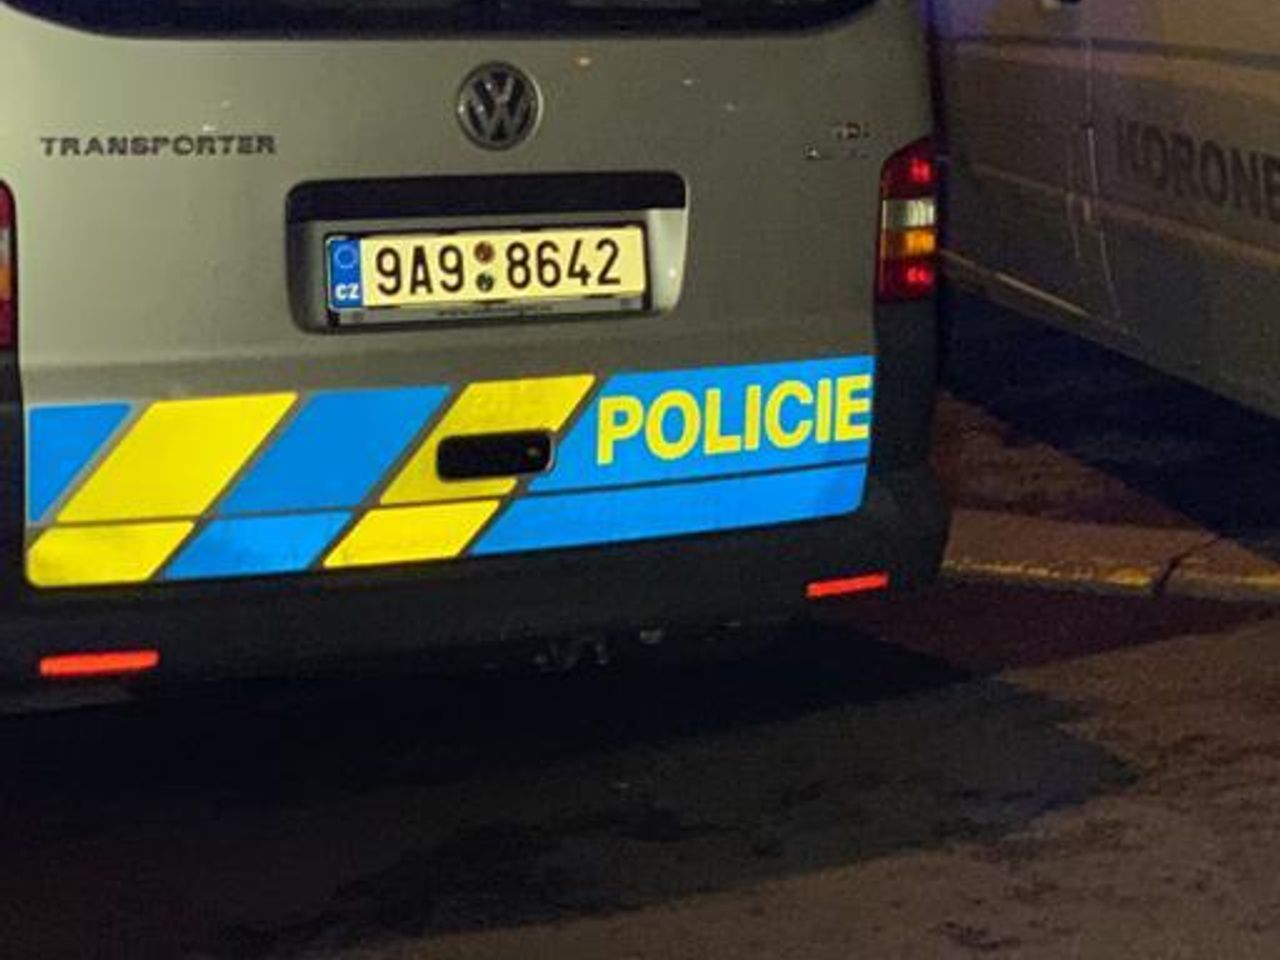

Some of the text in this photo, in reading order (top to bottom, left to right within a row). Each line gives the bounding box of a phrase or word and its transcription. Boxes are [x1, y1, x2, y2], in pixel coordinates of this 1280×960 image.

[39, 133, 277, 159] TRANSPORTER
[375, 237, 621, 296] 9A9 8642
[335, 282, 360, 301] CZ
[596, 373, 873, 466] POLICIE
